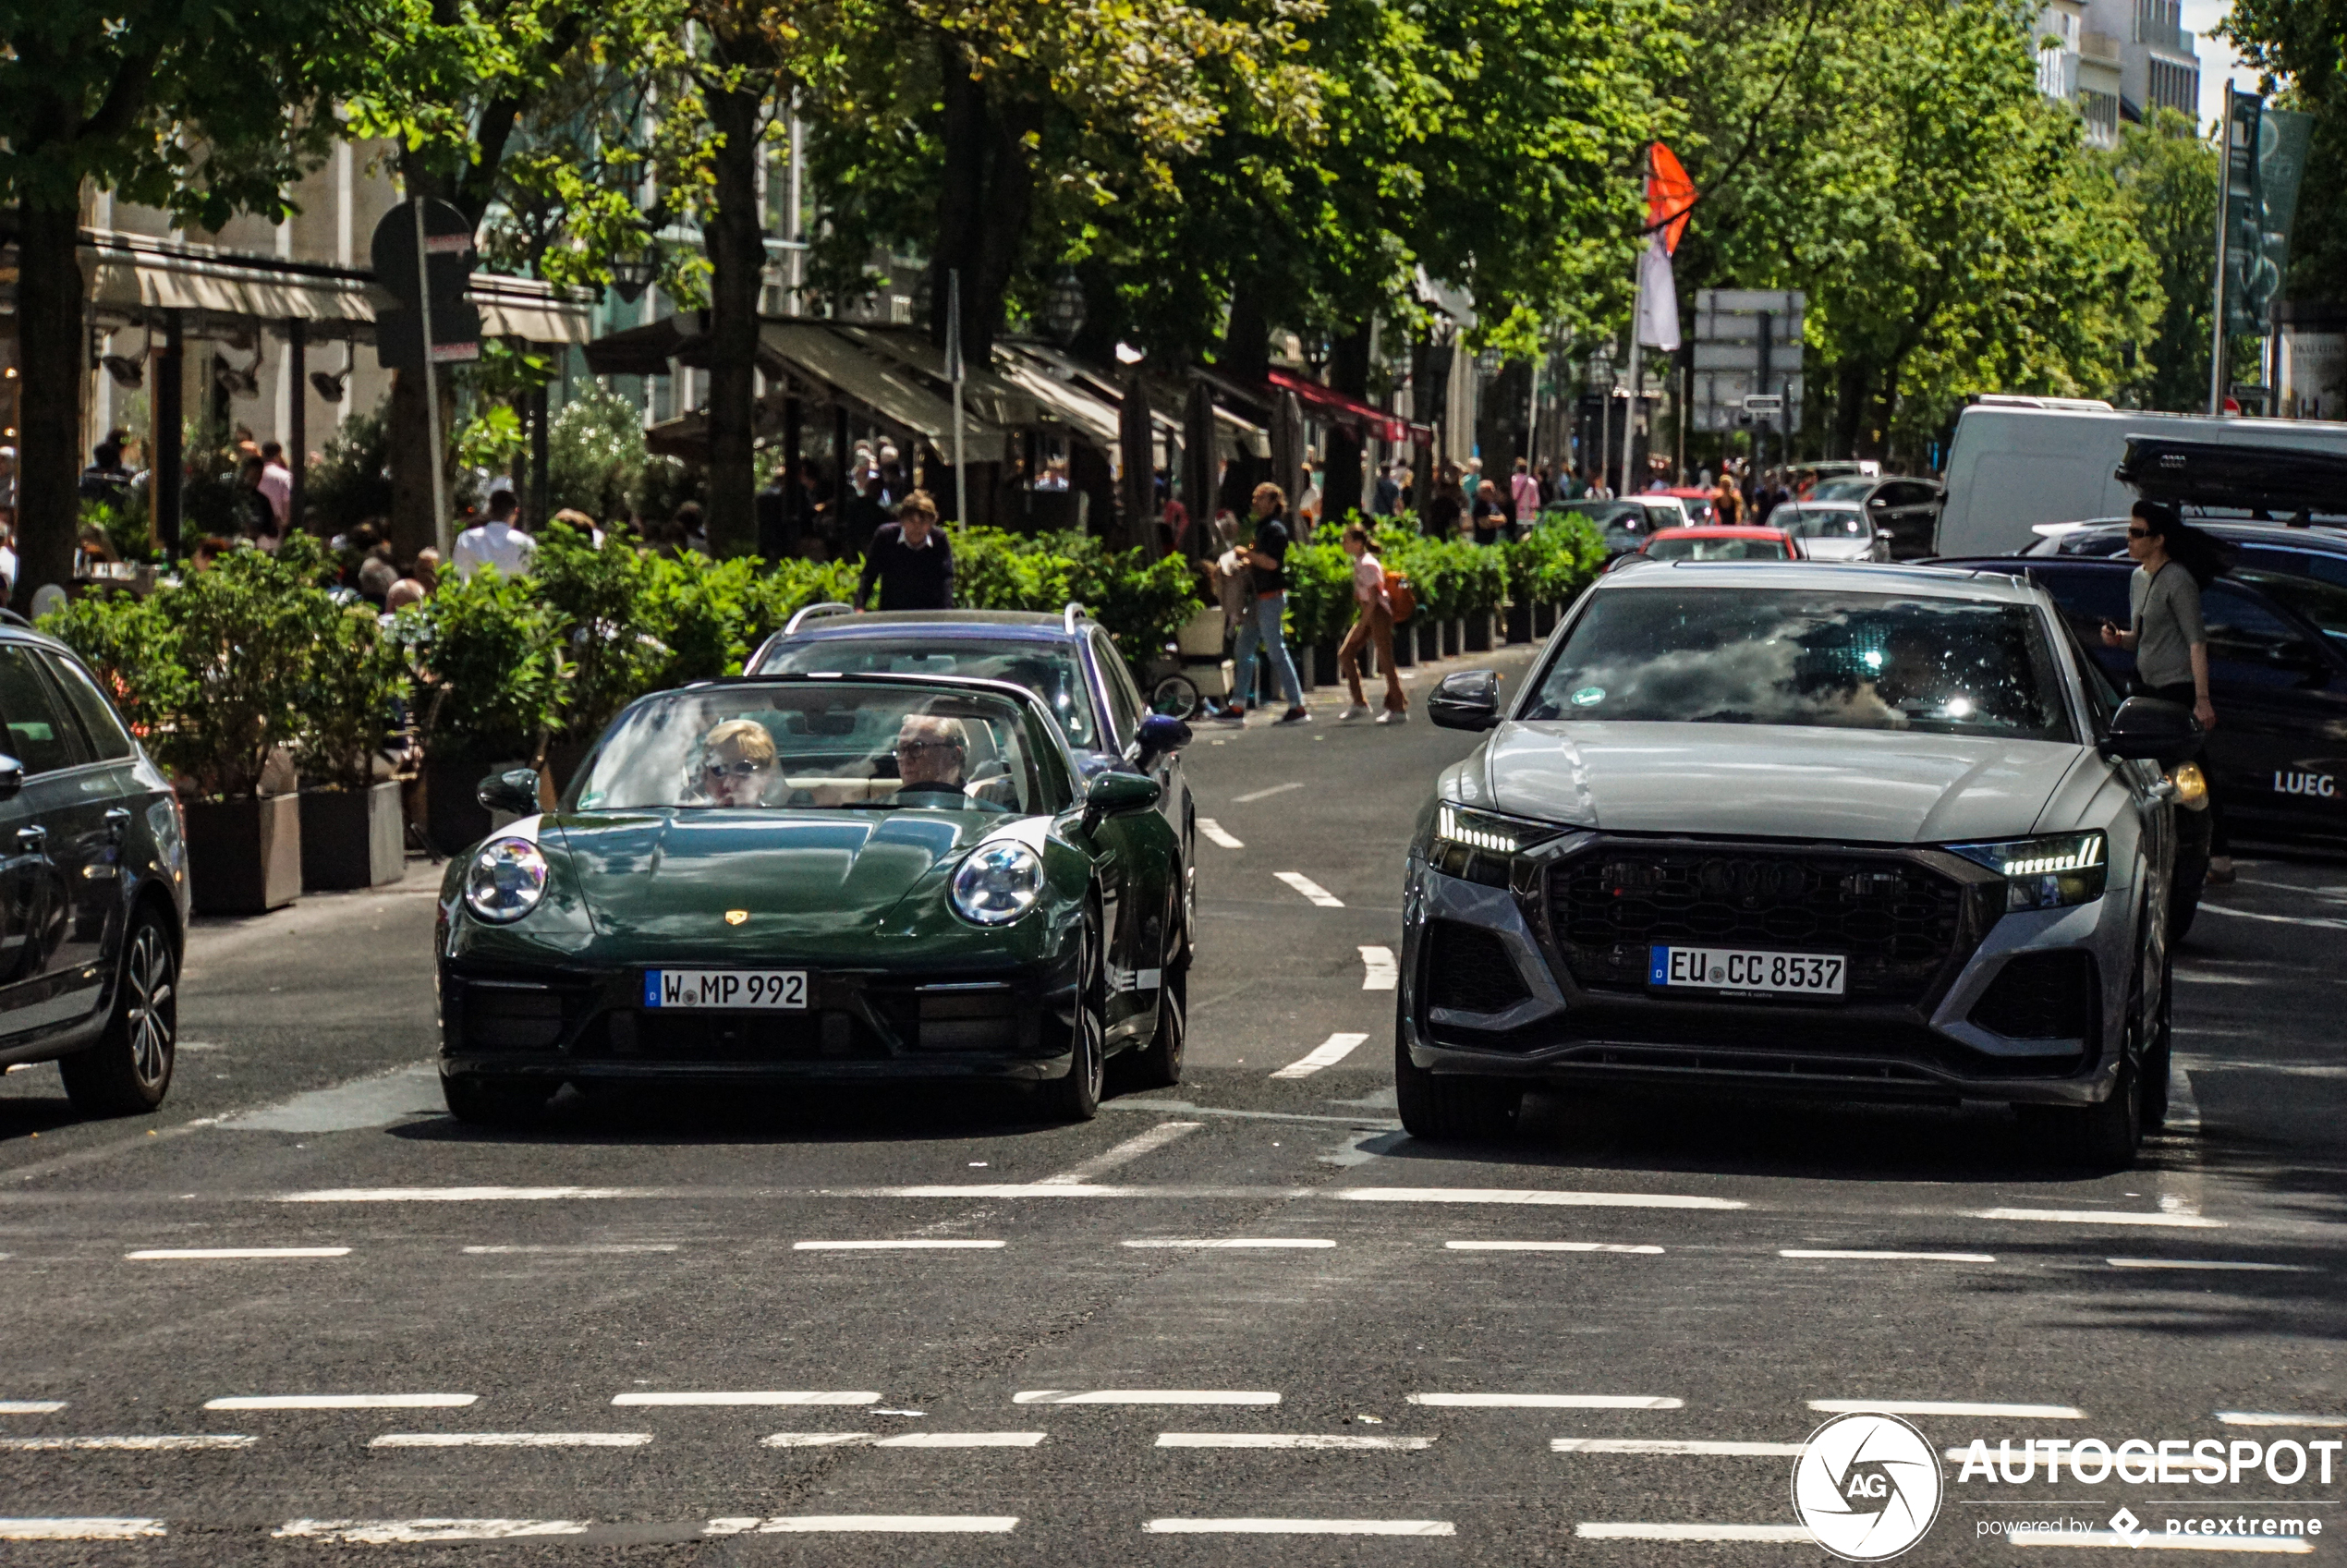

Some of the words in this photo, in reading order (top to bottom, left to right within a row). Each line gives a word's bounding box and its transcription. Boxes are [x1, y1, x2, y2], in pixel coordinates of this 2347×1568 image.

[2274, 771, 2335, 796] LUEG
[1656, 969, 1662, 978] D
[1670, 951, 1707, 982] EU
[1727, 954, 1763, 985] CC
[1770, 956, 1842, 989] 8537
[650, 991, 657, 1001] D
[664, 975, 682, 1003] W
[700, 975, 739, 1003] MP
[747, 975, 803, 1004] 992
